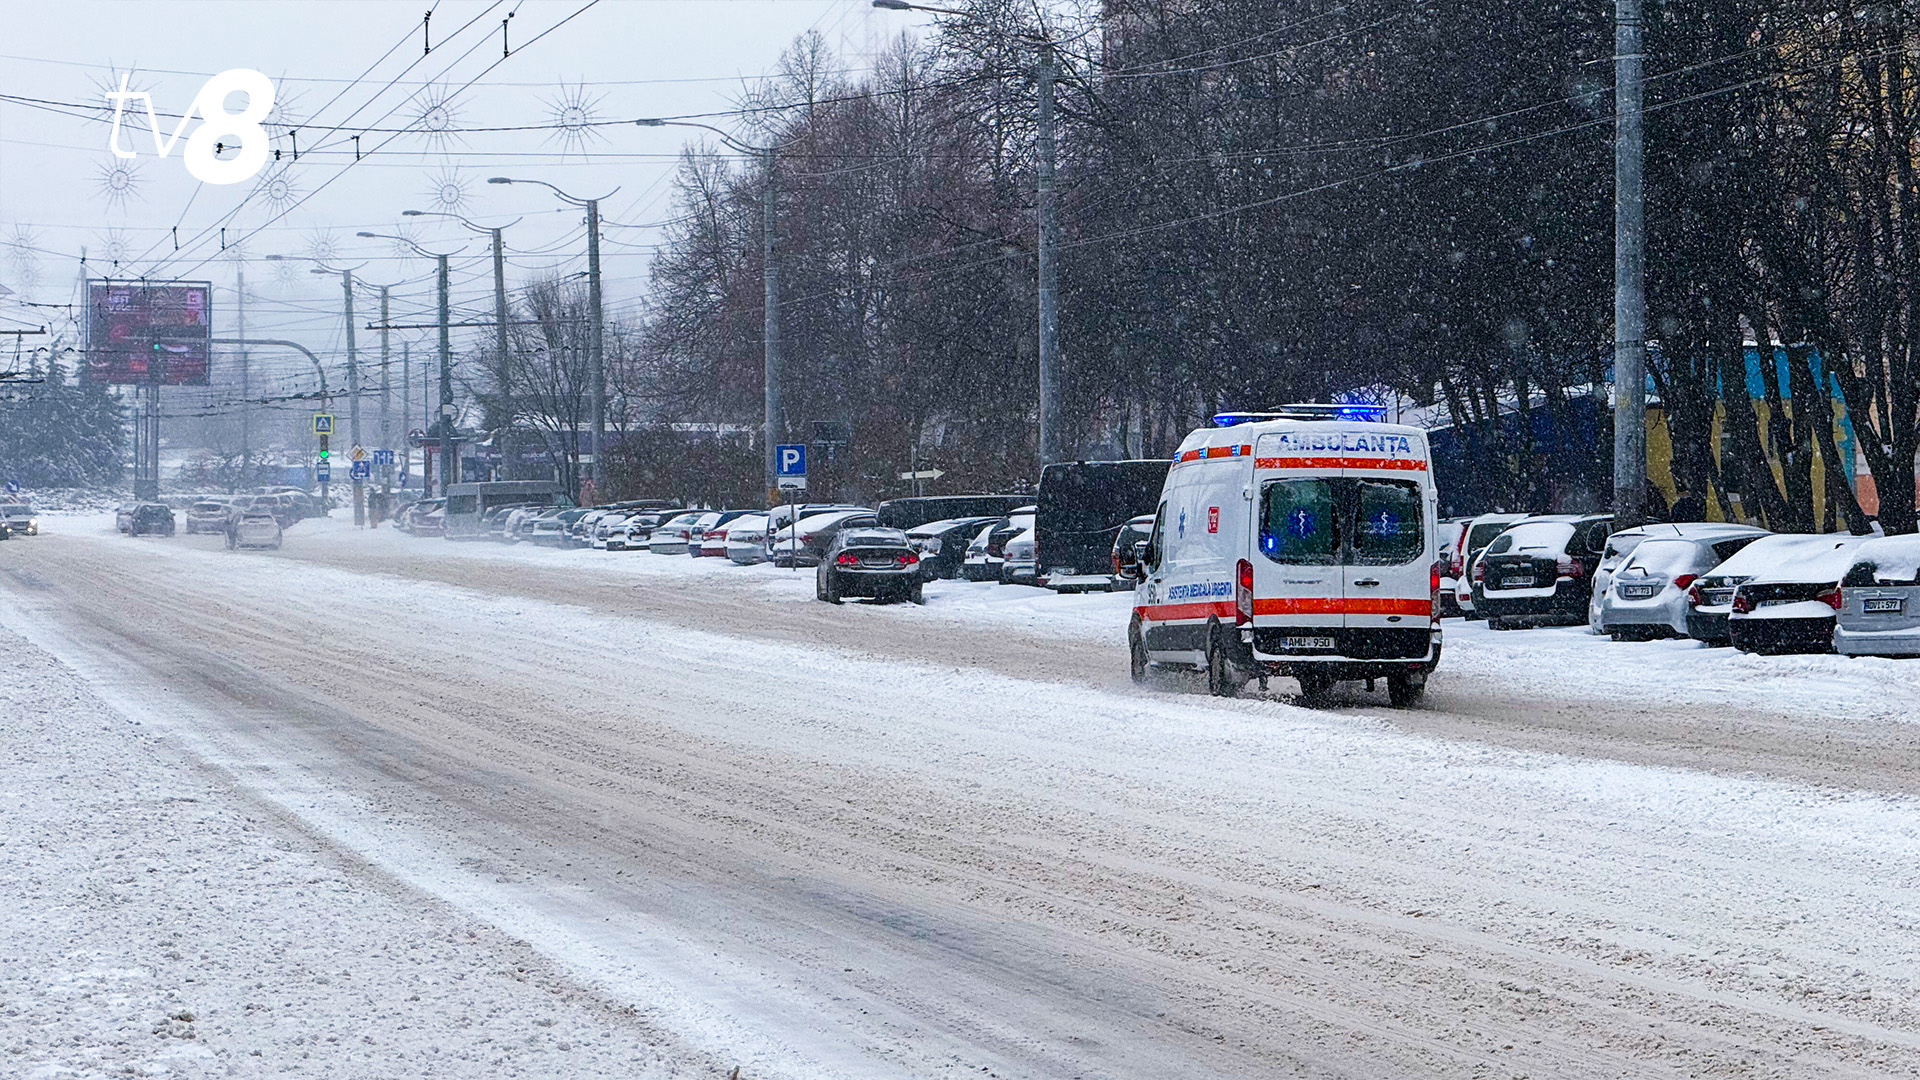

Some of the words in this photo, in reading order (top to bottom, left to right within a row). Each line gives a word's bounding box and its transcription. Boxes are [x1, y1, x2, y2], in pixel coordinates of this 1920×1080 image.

[782, 449, 800, 472] P
[1288, 637, 1307, 647] AMU
[1313, 637, 1331, 647] 950
